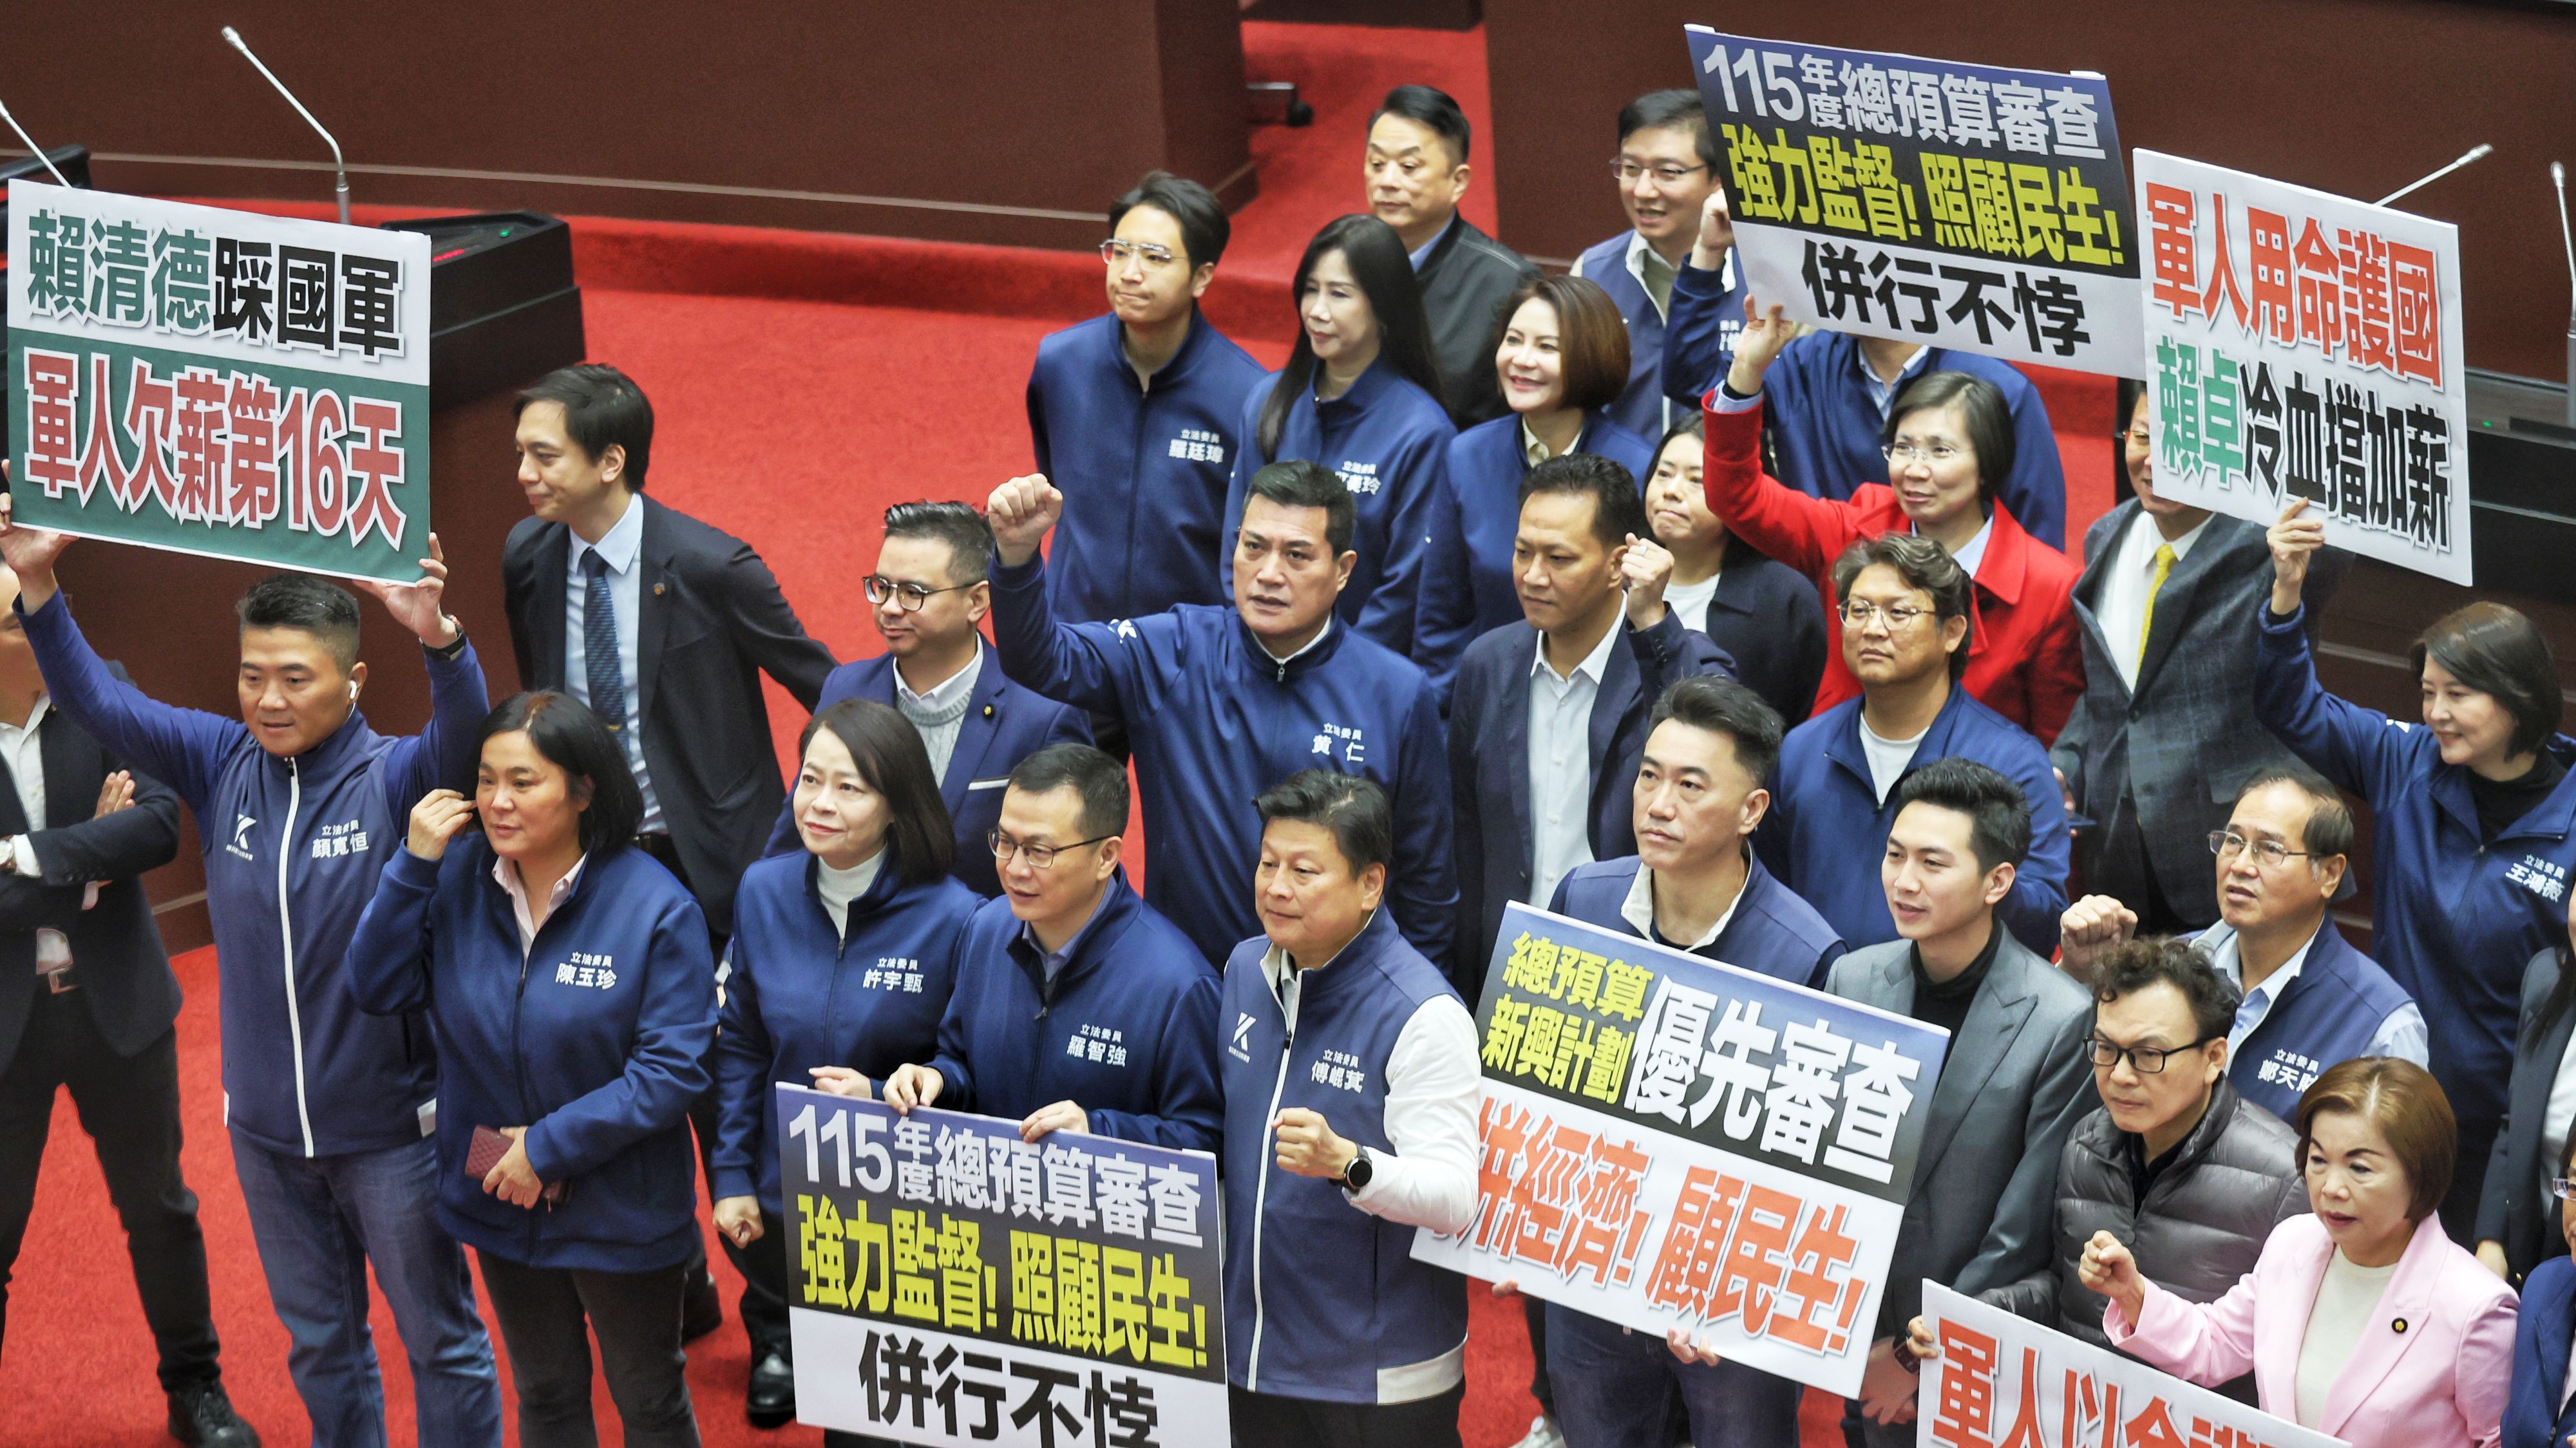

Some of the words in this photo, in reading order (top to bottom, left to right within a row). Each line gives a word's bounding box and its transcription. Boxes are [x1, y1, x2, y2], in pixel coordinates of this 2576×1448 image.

[1703, 44, 2106, 160] 115年度總預算審查
[1721, 124, 1922, 241] 強力監督!
[1919, 152, 2124, 267] 照顧民生!
[28, 207, 404, 361] 賴清德踩國軍
[1801, 238, 2091, 357] 併行不悖
[2145, 181, 2442, 390] 軍人用命護國
[24, 347, 407, 551] 軍人欠薪第16天
[2155, 335, 2451, 552] 賴卓冷血擋加薪
[321, 820, 360, 836] 立法委員
[555, 963, 618, 990] 陳玉珍
[570, 951, 612, 968] 立法委員
[862, 968, 924, 994] 許宇甄
[876, 957, 918, 971] 立法委員
[1501, 930, 1655, 1023] 總預算
[1066, 1034, 1128, 1068] 羅智強
[1079, 1023, 1122, 1044] 立法委員
[1322, 1049, 1359, 1069] 立法委員
[1481, 993, 1635, 1105] 新興計劃
[1622, 974, 1922, 1186] 優先審查
[2274, 1048, 2319, 1073] 立法委員
[788, 1104, 1204, 1249] 115年度總預算審查
[797, 1193, 998, 1333] 強力監督!
[1009, 1229, 1208, 1369] 照顧民生!
[1644, 1163, 1867, 1356] 顧民生!
[858, 1328, 1159, 1448] 併行不悖
